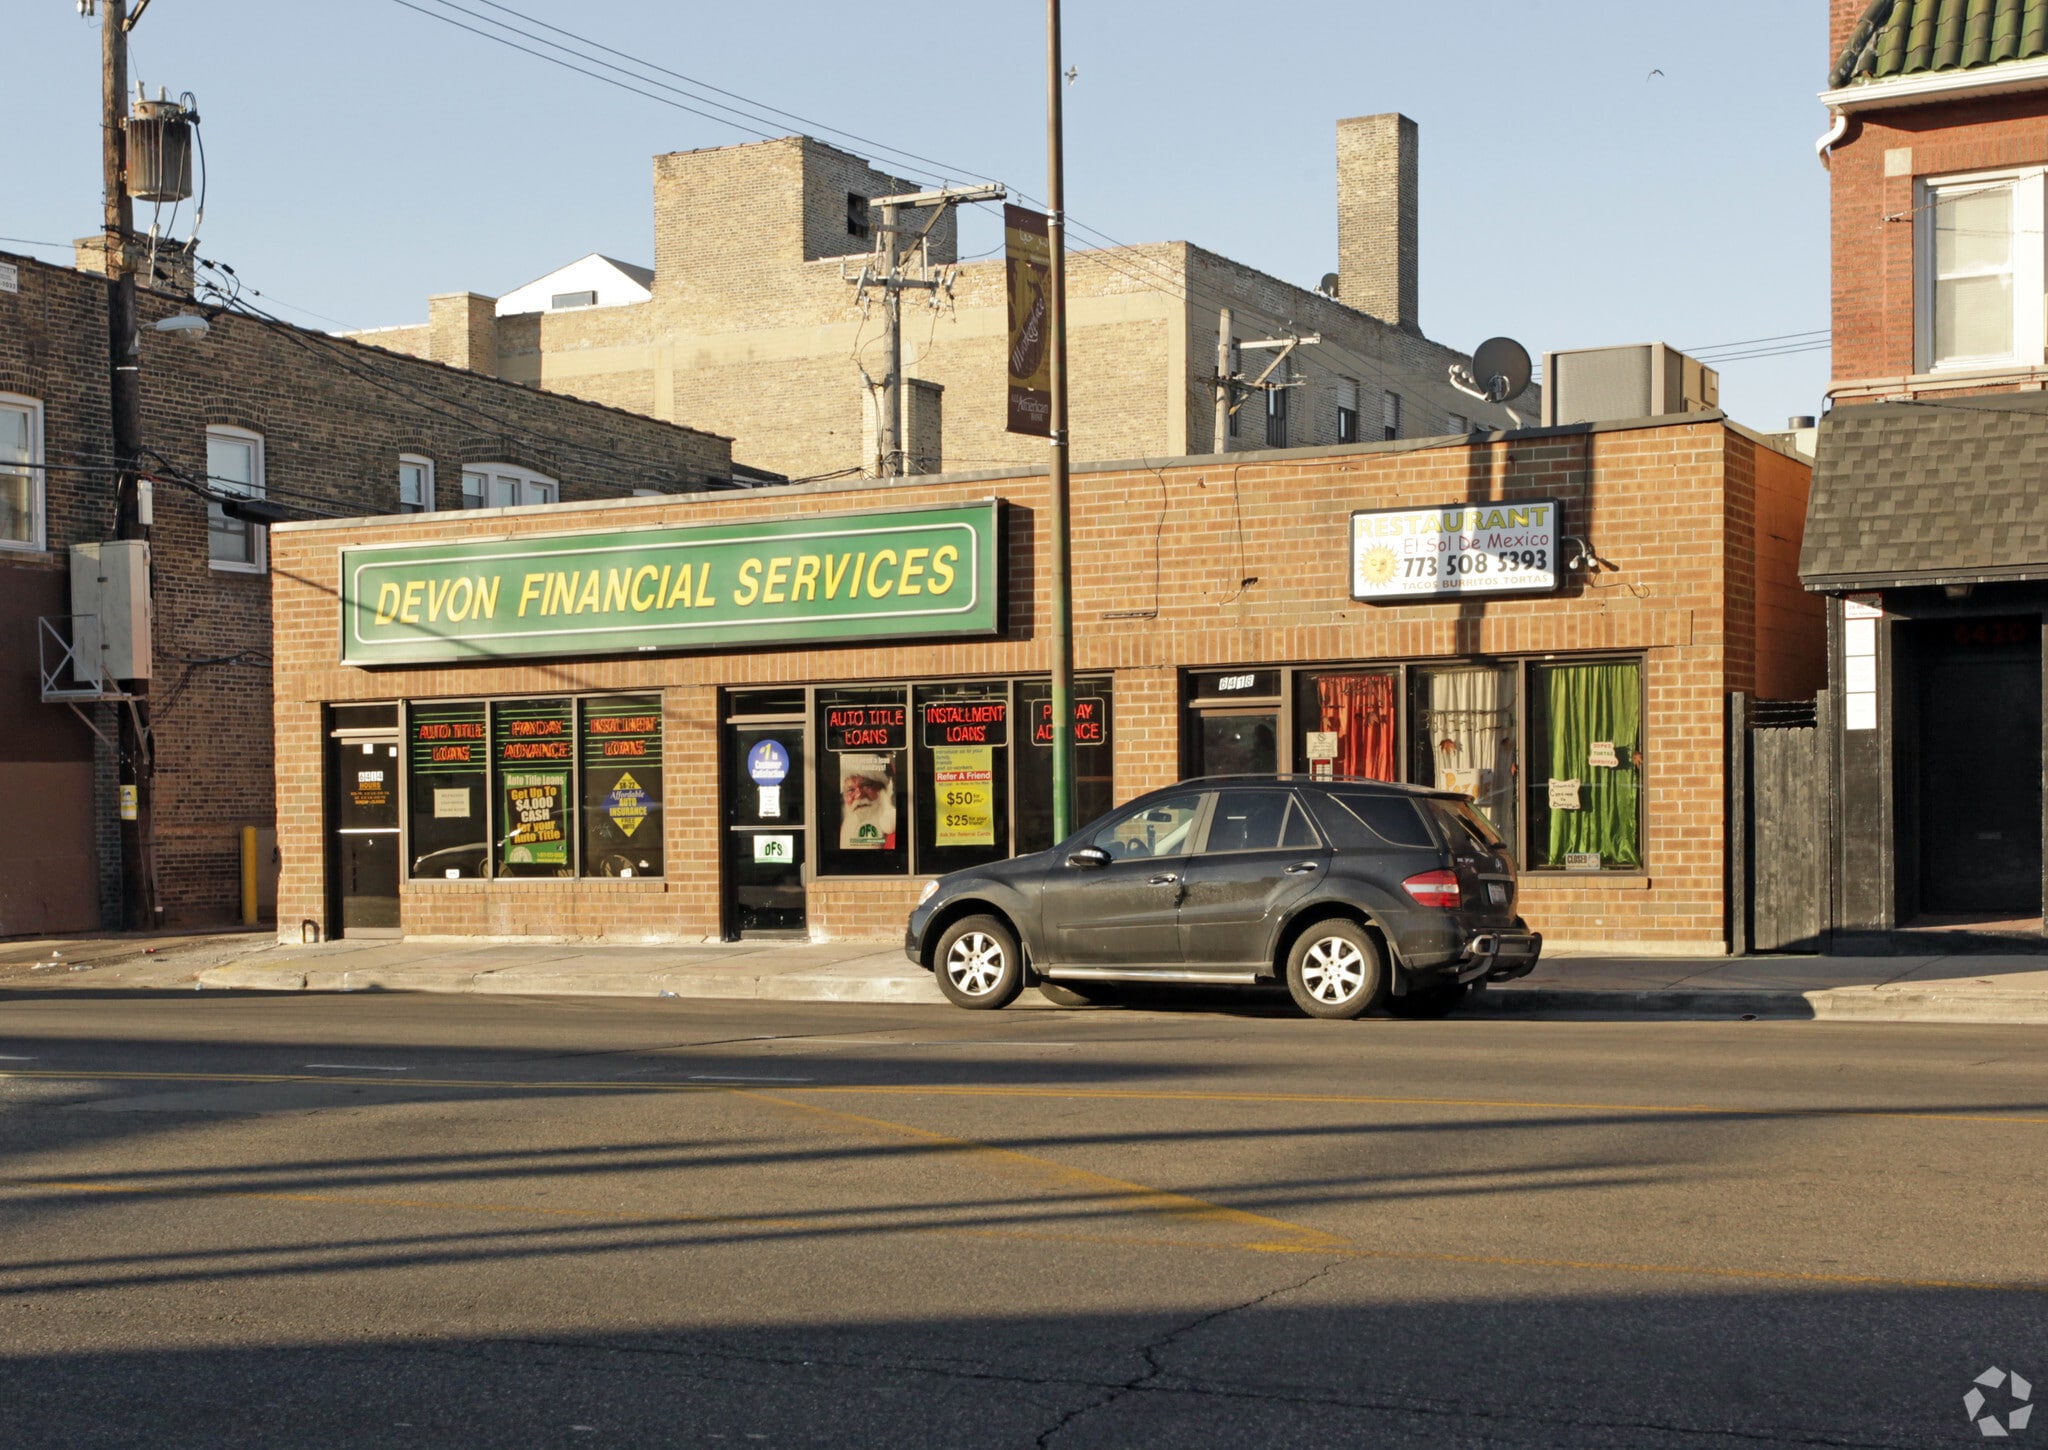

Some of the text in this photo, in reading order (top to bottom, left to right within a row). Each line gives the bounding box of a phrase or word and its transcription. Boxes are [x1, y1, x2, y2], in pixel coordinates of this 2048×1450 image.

[1356, 507, 1549, 538] RESTAURANT
[1404, 531, 1549, 555] El Sol De Mexico
[1404, 549, 1547, 578] 773 508 5393
[374, 544, 959, 625] DEVON FINANCIAL SERVICES
[1403, 574, 1548, 590] TACOS BURRITOS TORTAS
[1220, 676, 1254, 690] 6418
[830, 709, 904, 727] AUTO TITLE
[927, 706, 1005, 723] INSTALLMENT
[1043, 704, 1093, 720] PAY
[420, 723, 483, 740] AUTO TITLE
[511, 721, 562, 736] PAYDAY
[946, 726, 985, 742] LOANS
[1036, 723, 1100, 741] ADNCE
[845, 729, 888, 745] LOANS
[432, 746, 470, 762] LOANS
[503, 743, 569, 759] ADVANCE
[604, 740, 646, 756] LOANS
[507, 774, 564, 785] Auto Title Loans
[937, 773, 957, 781] Refer
[966, 771, 991, 780] Friend
[511, 786, 557, 801] Get Up To
[610, 789, 645, 801] Affordable
[946, 791, 973, 806] $50
[619, 797, 638, 807] AUTO
[521, 808, 551, 823] CASH
[609, 806, 648, 817] INSURANCE
[532, 820, 556, 833] your
[946, 814, 969, 827] $25
[514, 829, 561, 844] Auto Title
[1567, 855, 1588, 864] CLOSED
